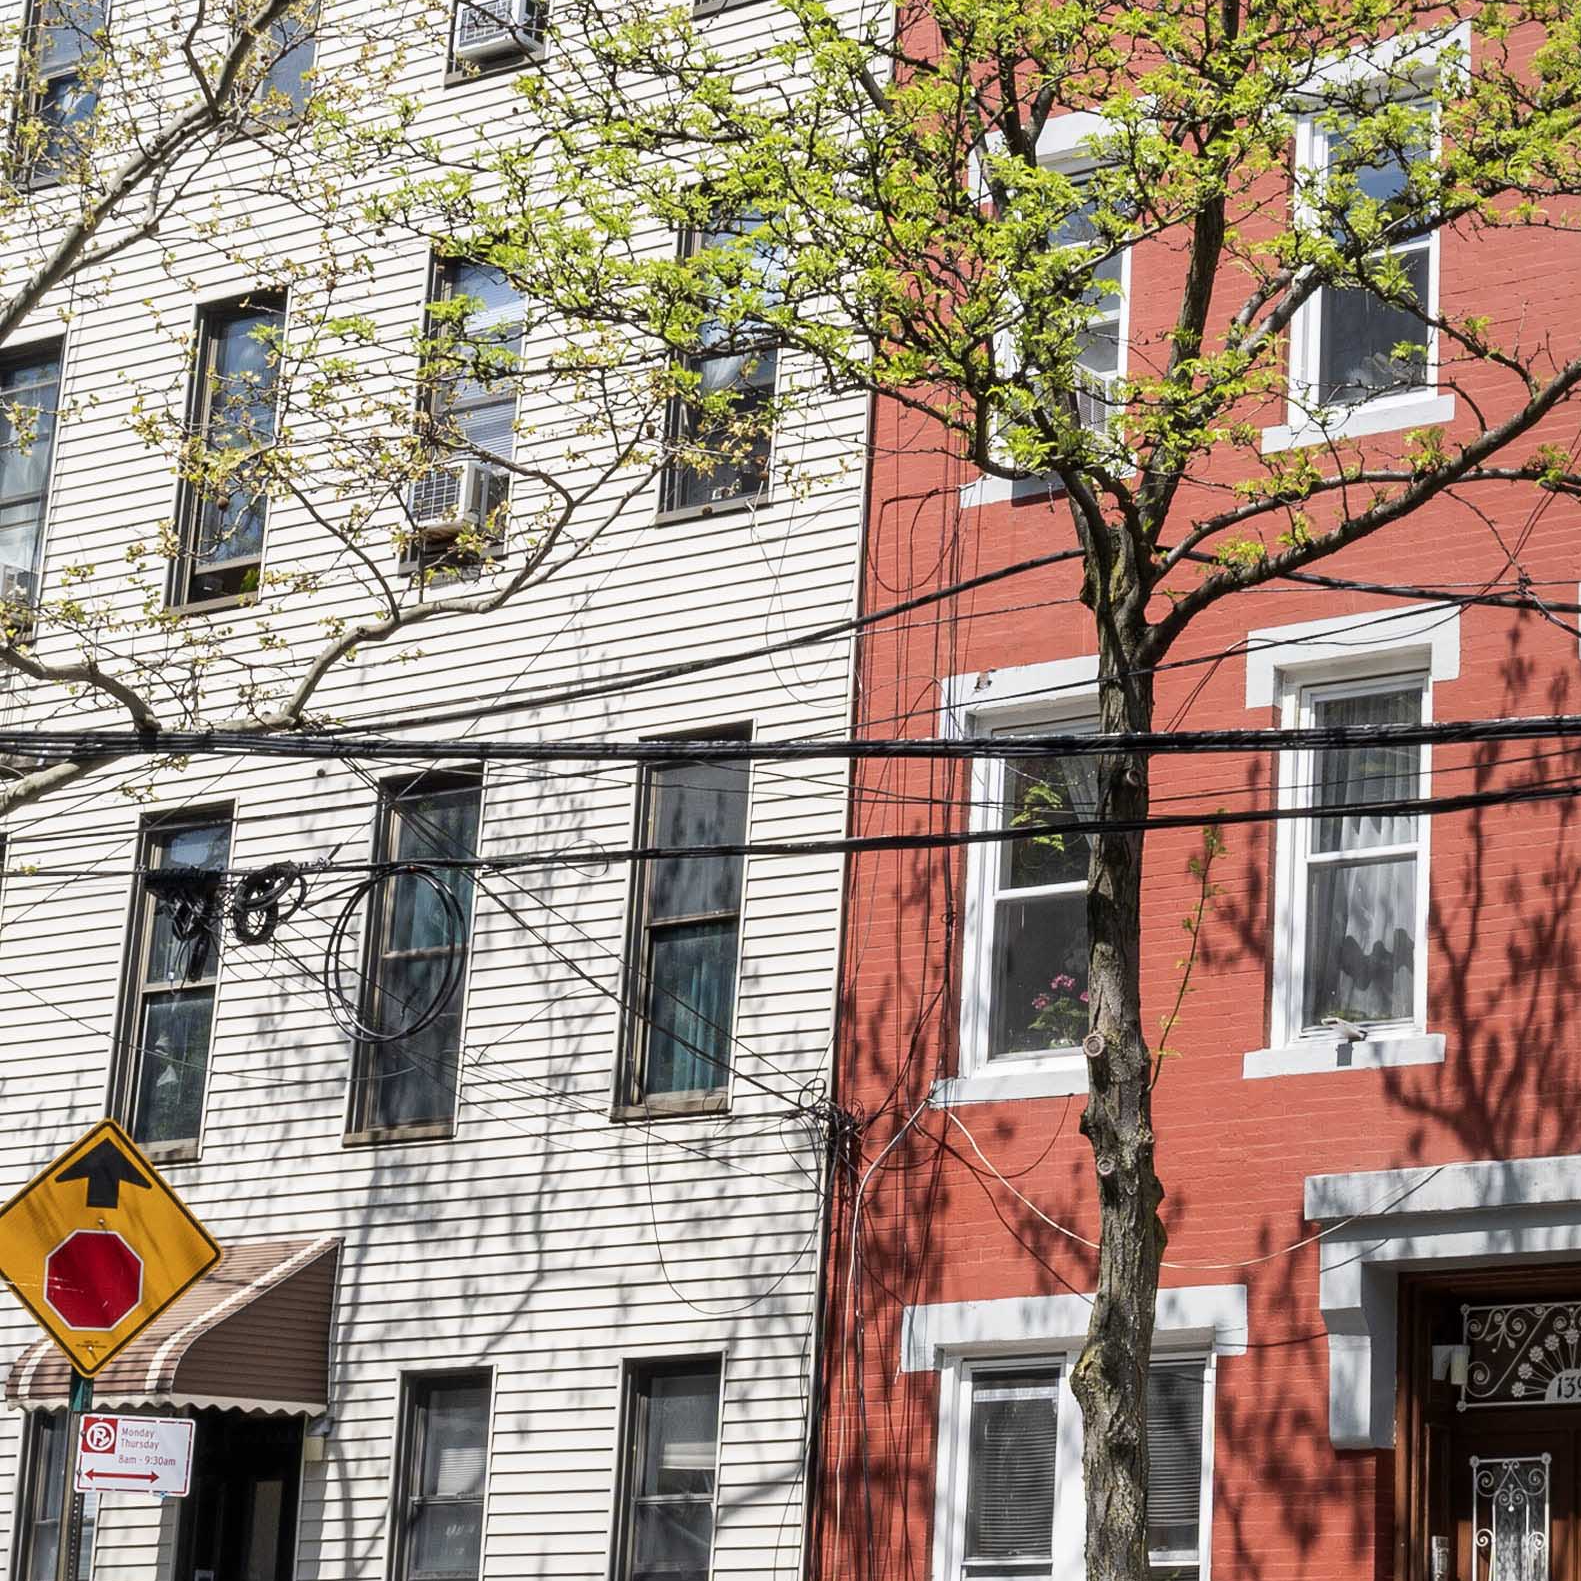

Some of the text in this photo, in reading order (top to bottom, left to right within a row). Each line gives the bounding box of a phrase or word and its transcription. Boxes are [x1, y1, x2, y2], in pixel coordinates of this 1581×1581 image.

[121, 1427, 155, 1439] Monday
[121, 1439, 160, 1451] Thursday
[118, 1455, 137, 1465] 8am
[144, 1455, 176, 1466] 9:30am
